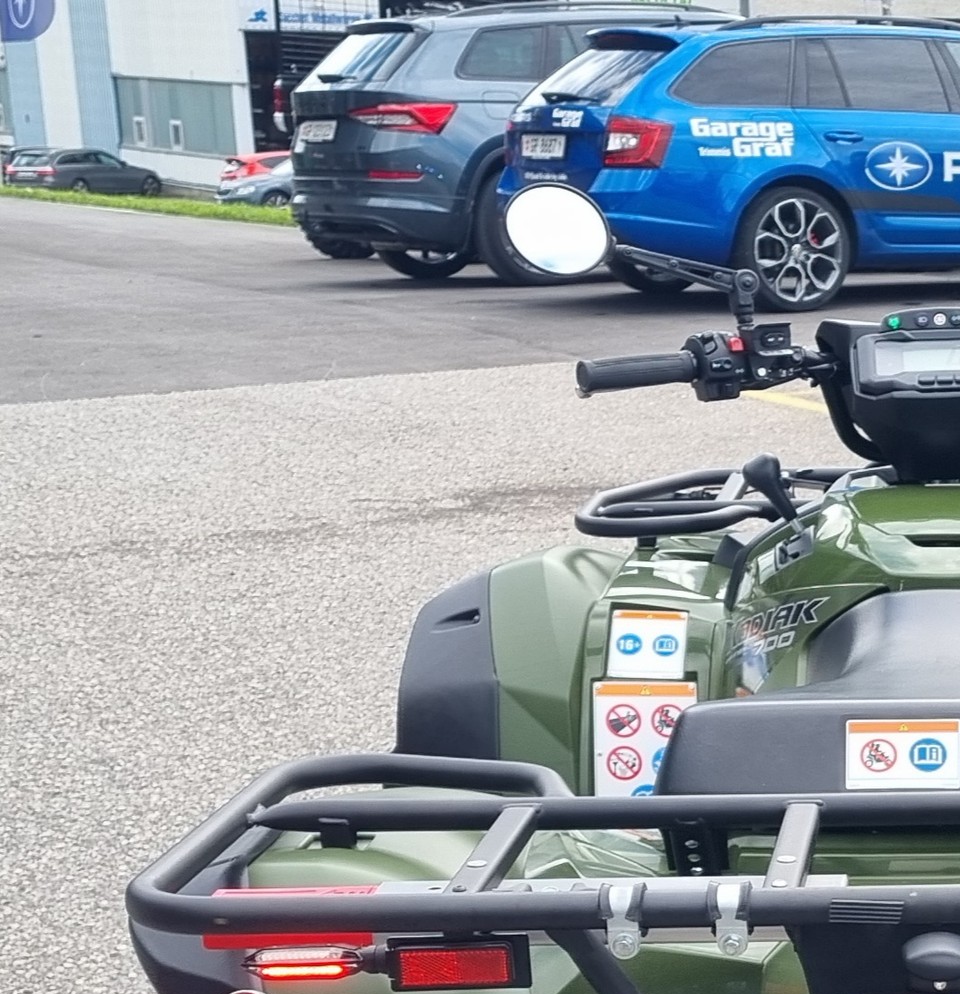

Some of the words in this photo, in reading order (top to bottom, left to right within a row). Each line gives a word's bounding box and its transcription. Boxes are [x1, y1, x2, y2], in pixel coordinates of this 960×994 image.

[690, 118, 795, 142] Garage
[732, 137, 796, 157] Graf
[619, 638, 641, 650] 16+
[752, 630, 797, 656] 700
